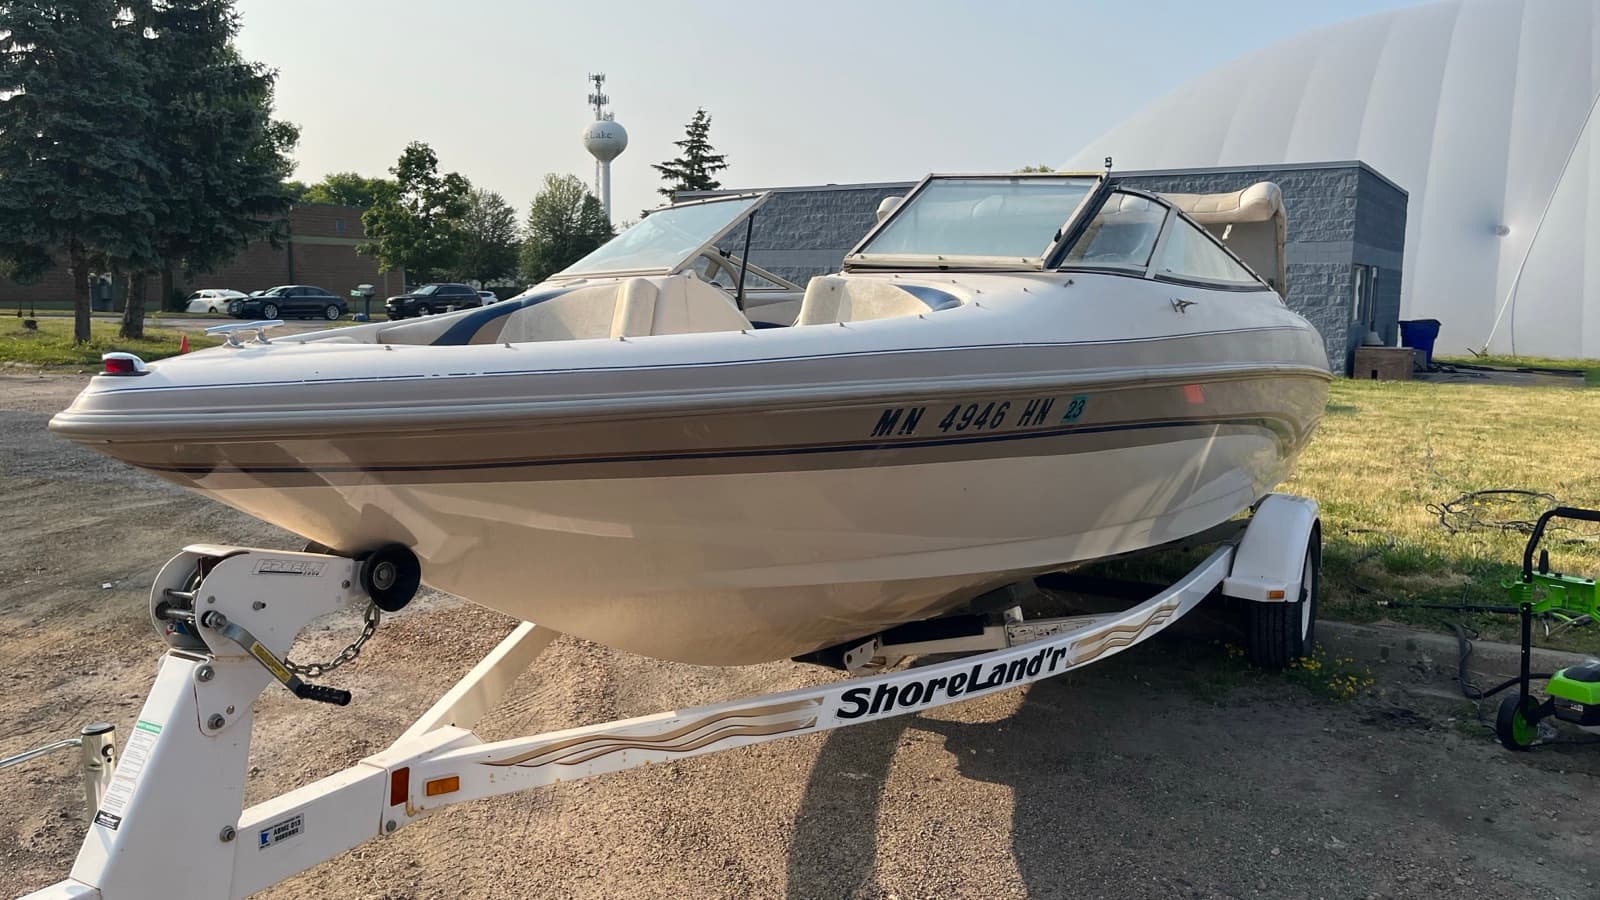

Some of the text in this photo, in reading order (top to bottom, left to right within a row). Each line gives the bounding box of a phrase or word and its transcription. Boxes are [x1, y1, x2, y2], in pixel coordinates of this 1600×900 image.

[590, 130, 613, 139] Lake
[870, 397, 1056, 437] MN 4946 HN
[1064, 399, 1086, 420] 23
[836, 646, 1067, 719] ShoreLand'r
